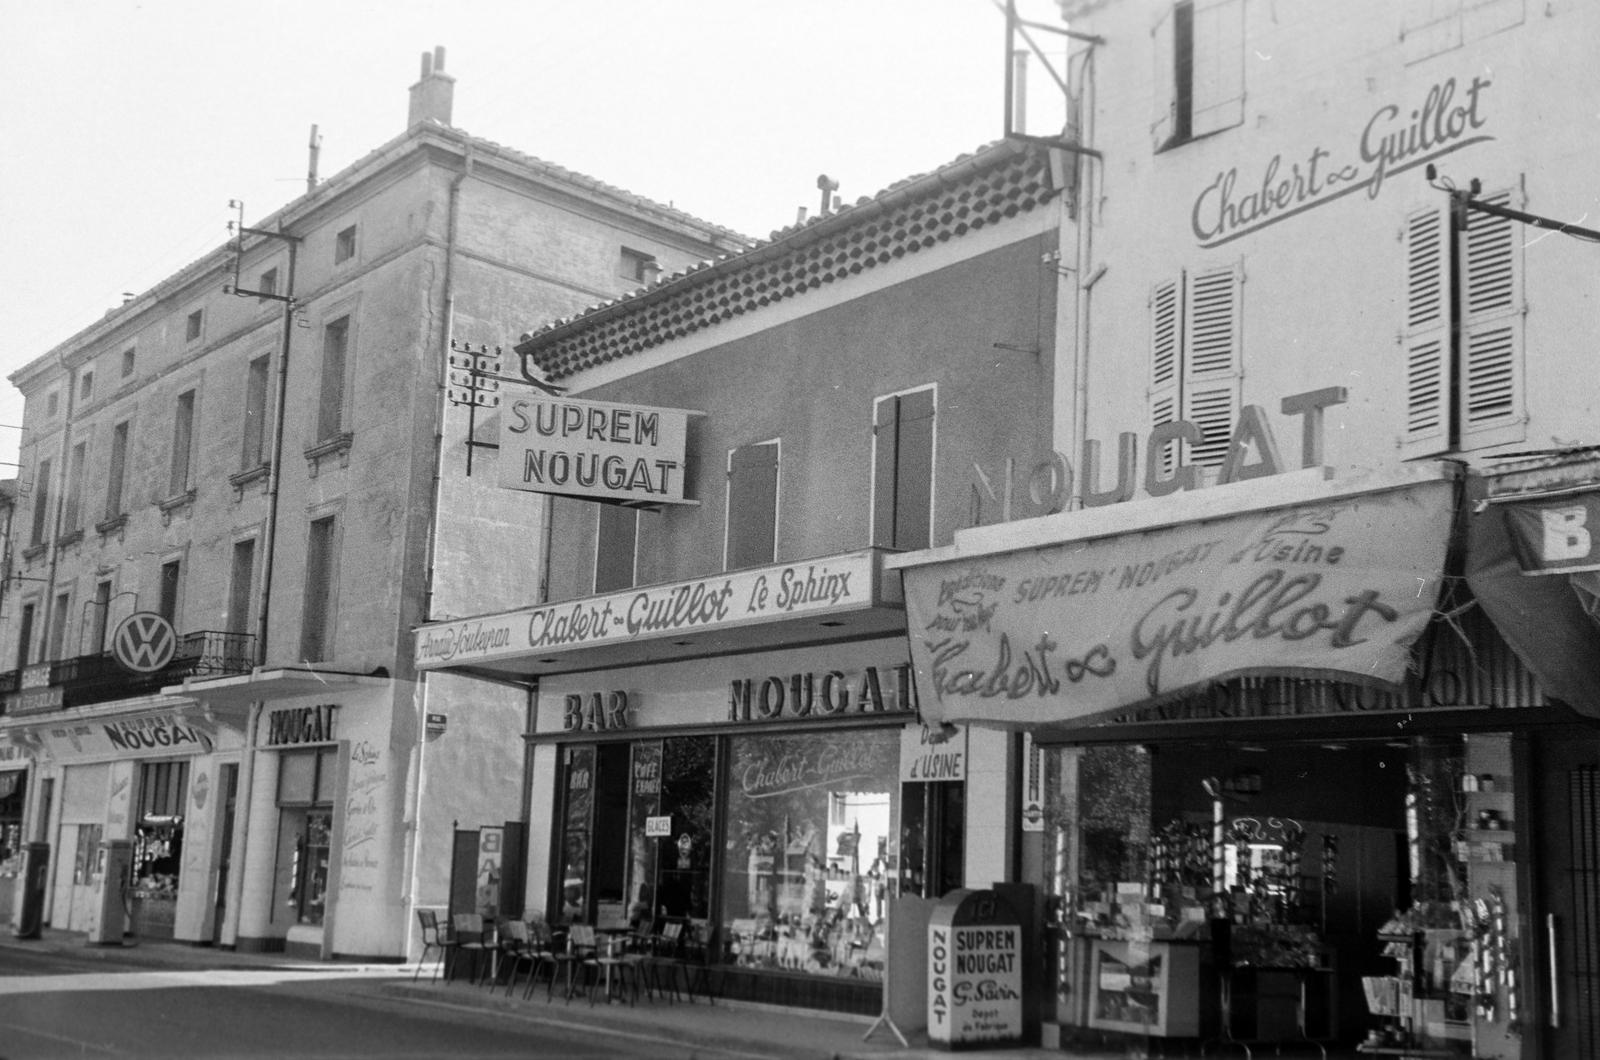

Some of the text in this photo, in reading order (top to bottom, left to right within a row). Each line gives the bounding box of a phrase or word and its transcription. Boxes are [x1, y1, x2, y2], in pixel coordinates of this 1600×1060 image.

[1192, 146, 1331, 241] Chabert
[1359, 77, 1492, 200] Guillot
[508, 400, 660, 447] SUPREM
[523, 448, 678, 495] NOUGAT
[970, 386, 1349, 528] NOUGAT
[528, 608, 613, 648] Chabert
[626, 580, 734, 637] Guillot
[747, 580, 768, 614] Le
[776, 566, 852, 612] Sphinx
[1130, 567, 1400, 698] Guillot
[564, 690, 628, 733] BAR
[729, 662, 913, 722] NOUGAT
[269, 703, 342, 746] NOUGAT
[956, 931, 1015, 952] SUPREM
[956, 954, 1016, 974] NOUGAT
[932, 930, 947, 1025] NOUGAT
